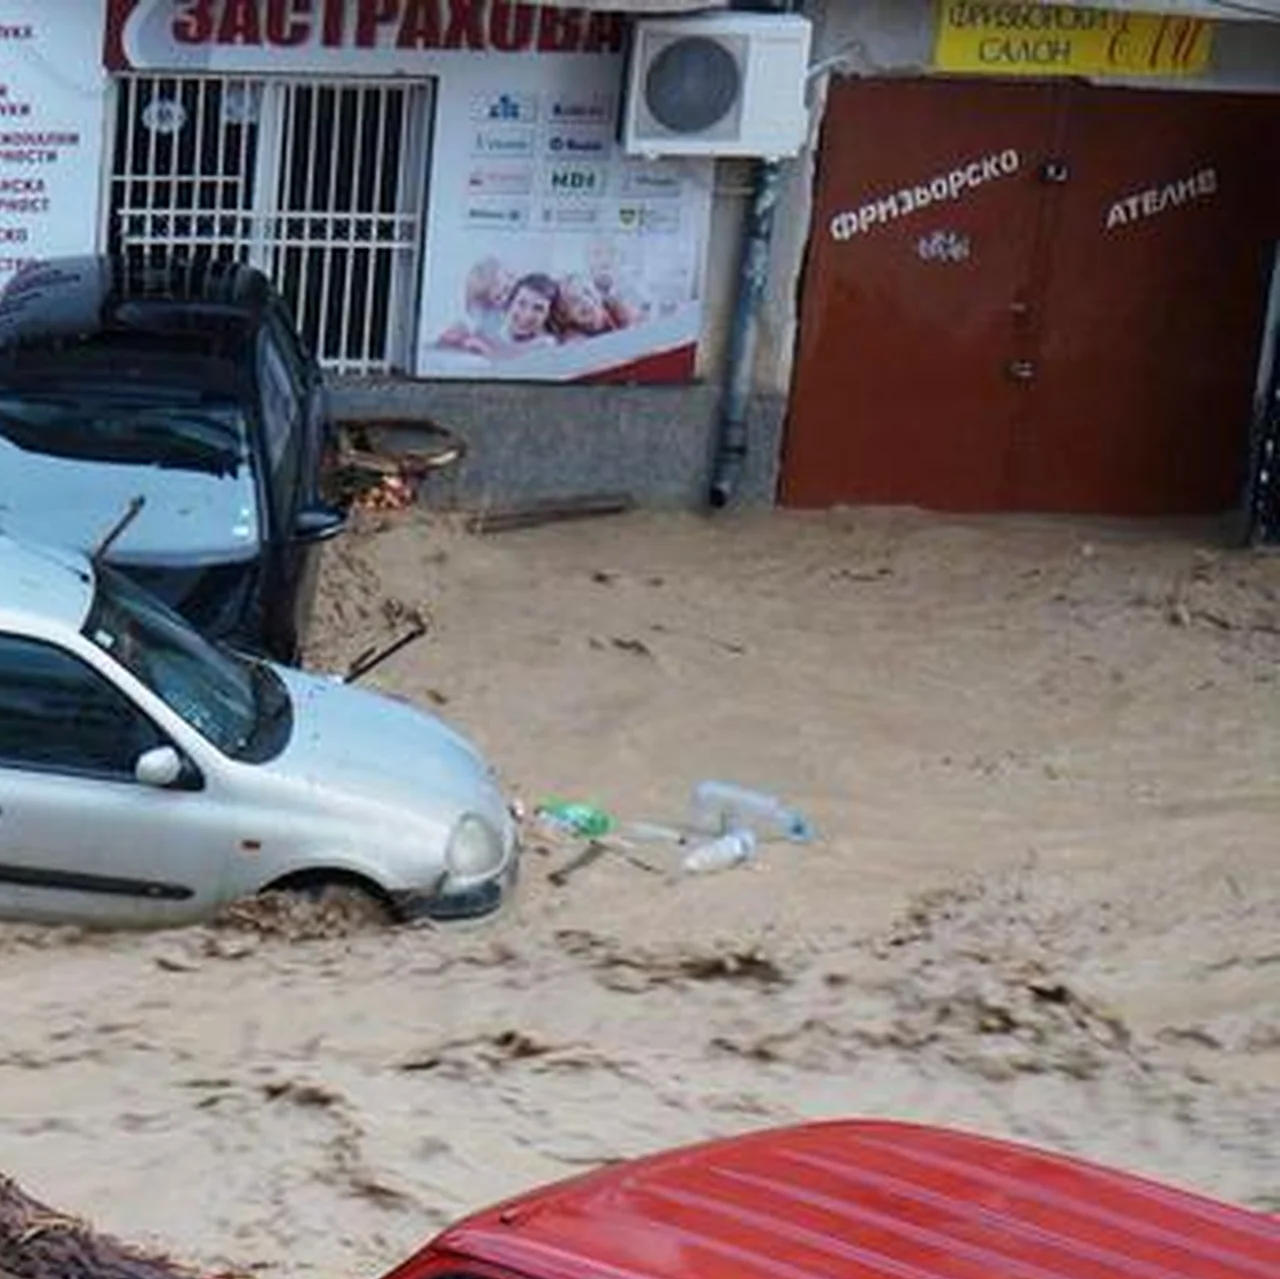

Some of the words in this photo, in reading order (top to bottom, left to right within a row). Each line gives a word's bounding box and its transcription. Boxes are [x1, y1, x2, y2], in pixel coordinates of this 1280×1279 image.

[172, 0, 623, 54] ЗАСТРАХОВА
[979, 35, 1072, 65] САЛОН
[829, 148, 1020, 241] ФРИЗЬОРСКО
[1105, 166, 1217, 230] АТЕЛИЕ
